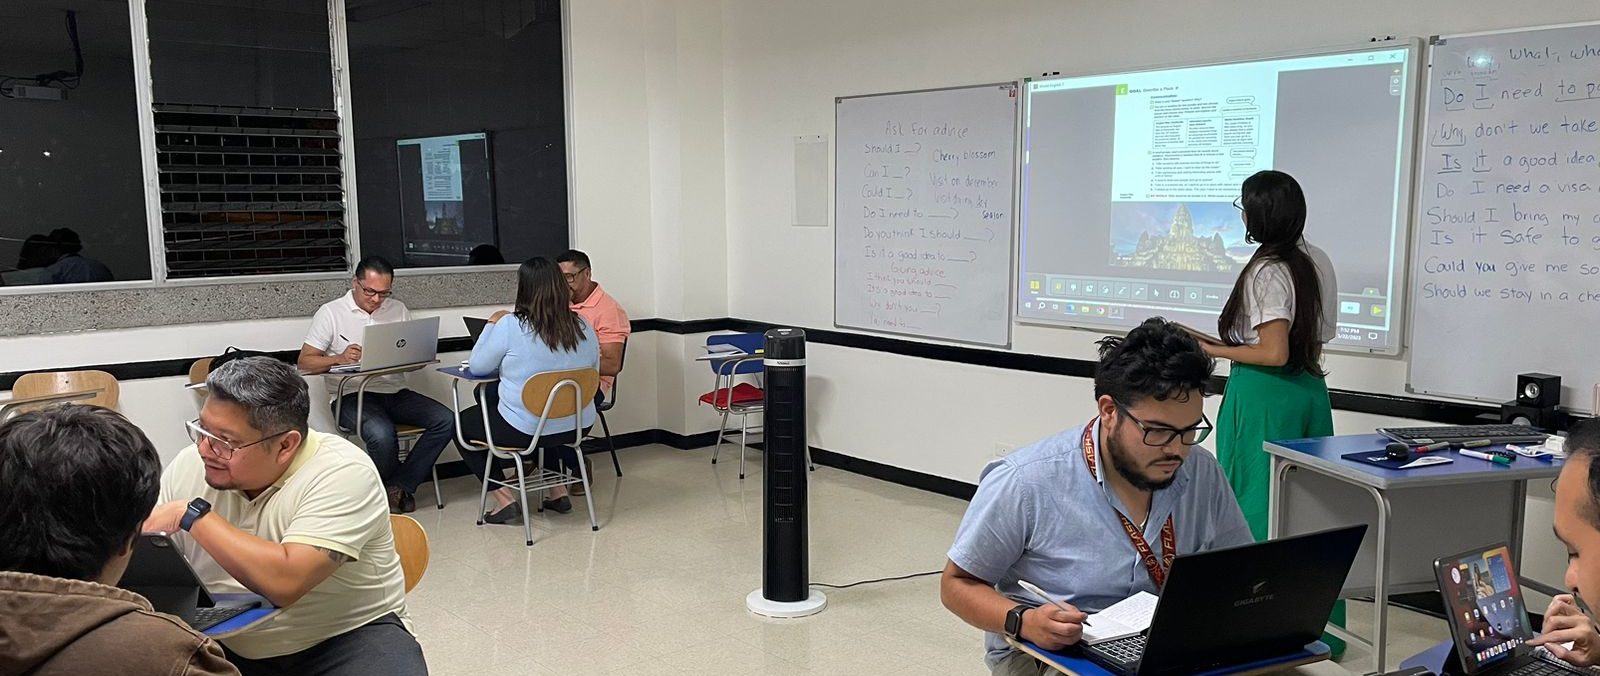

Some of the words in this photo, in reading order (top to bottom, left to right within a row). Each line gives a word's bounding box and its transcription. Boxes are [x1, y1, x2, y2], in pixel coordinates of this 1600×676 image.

[1443, 86, 1464, 105] Do
[1475, 83, 1489, 101] I
[1502, 82, 1543, 100] need
[1558, 80, 1576, 96] to
[884, 120, 904, 137] Ask
[932, 122, 969, 139] advice
[1474, 120, 1519, 138] don't
[1530, 122, 1550, 136] we
[1560, 114, 1599, 135] take
[1441, 153, 1463, 170] Is
[1475, 149, 1489, 168] it
[1502, 155, 1513, 167] a
[1518, 152, 1557, 173] good
[1566, 151, 1596, 165] idea
[1436, 182, 1455, 199] Do
[1469, 180, 1486, 195] I
[1495, 180, 1531, 194] need
[1538, 184, 1550, 194] a
[1557, 182, 1592, 193] visa
[863, 206, 876, 219] Do
[879, 208, 886, 218] I
[889, 208, 910, 219] need
[1426, 206, 1476, 225] Should
[1484, 207, 1500, 223] I
[1513, 202, 1549, 226] bring
[1562, 213, 1580, 226] my
[863, 226, 874, 239] Do
[1430, 229, 1454, 246] Is
[1470, 226, 1488, 245] it
[1561, 225, 1580, 247] to
[897, 248, 918, 262] good
[1424, 255, 1466, 274] Could
[1475, 261, 1497, 276] you
[1504, 261, 1536, 277] give
[1545, 262, 1569, 273] me
[1423, 282, 1467, 299] Should
[1473, 287, 1492, 298] we
[1540, 290, 1552, 301] in
[1558, 291, 1569, 301] a
